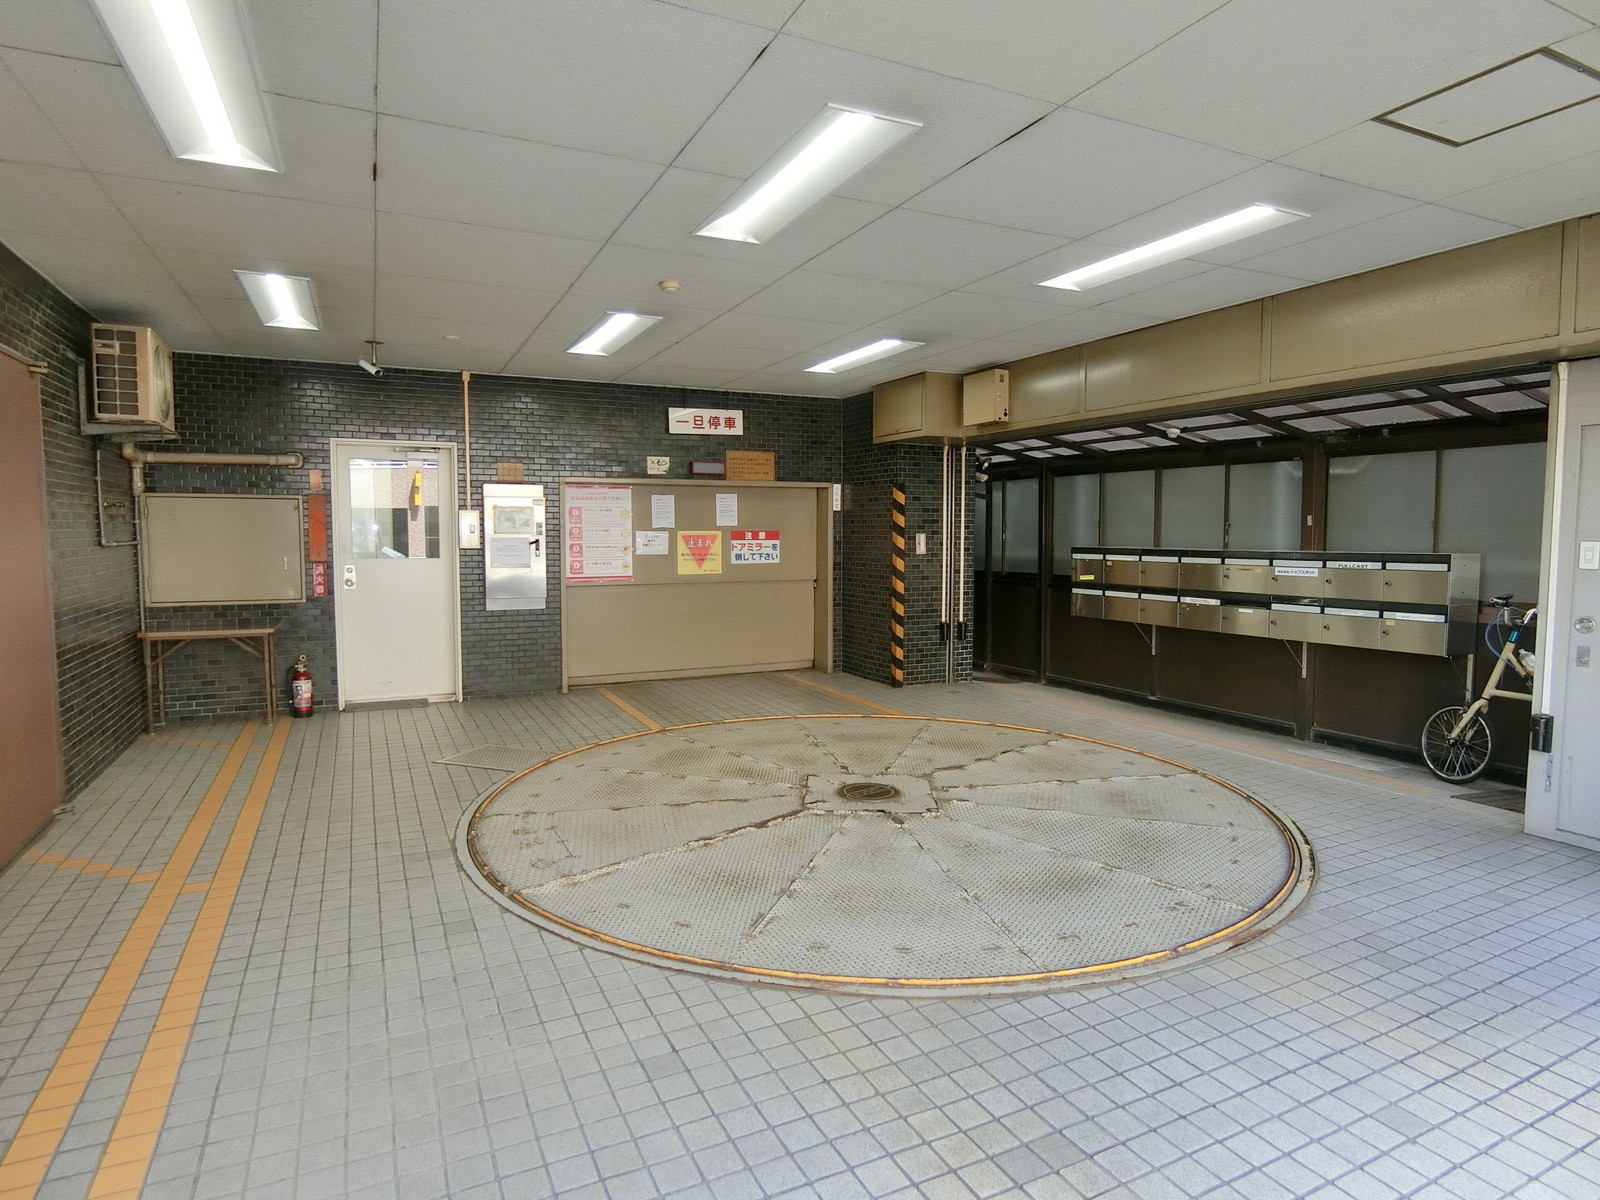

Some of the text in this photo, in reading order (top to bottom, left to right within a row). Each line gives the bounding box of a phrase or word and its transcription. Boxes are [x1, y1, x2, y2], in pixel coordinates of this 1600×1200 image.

[675, 415, 737, 430] 一旦停車
[744, 531, 766, 540] 注意
[687, 538, 713, 548] 止まれ
[731, 542, 779, 551] ドアミラーを
